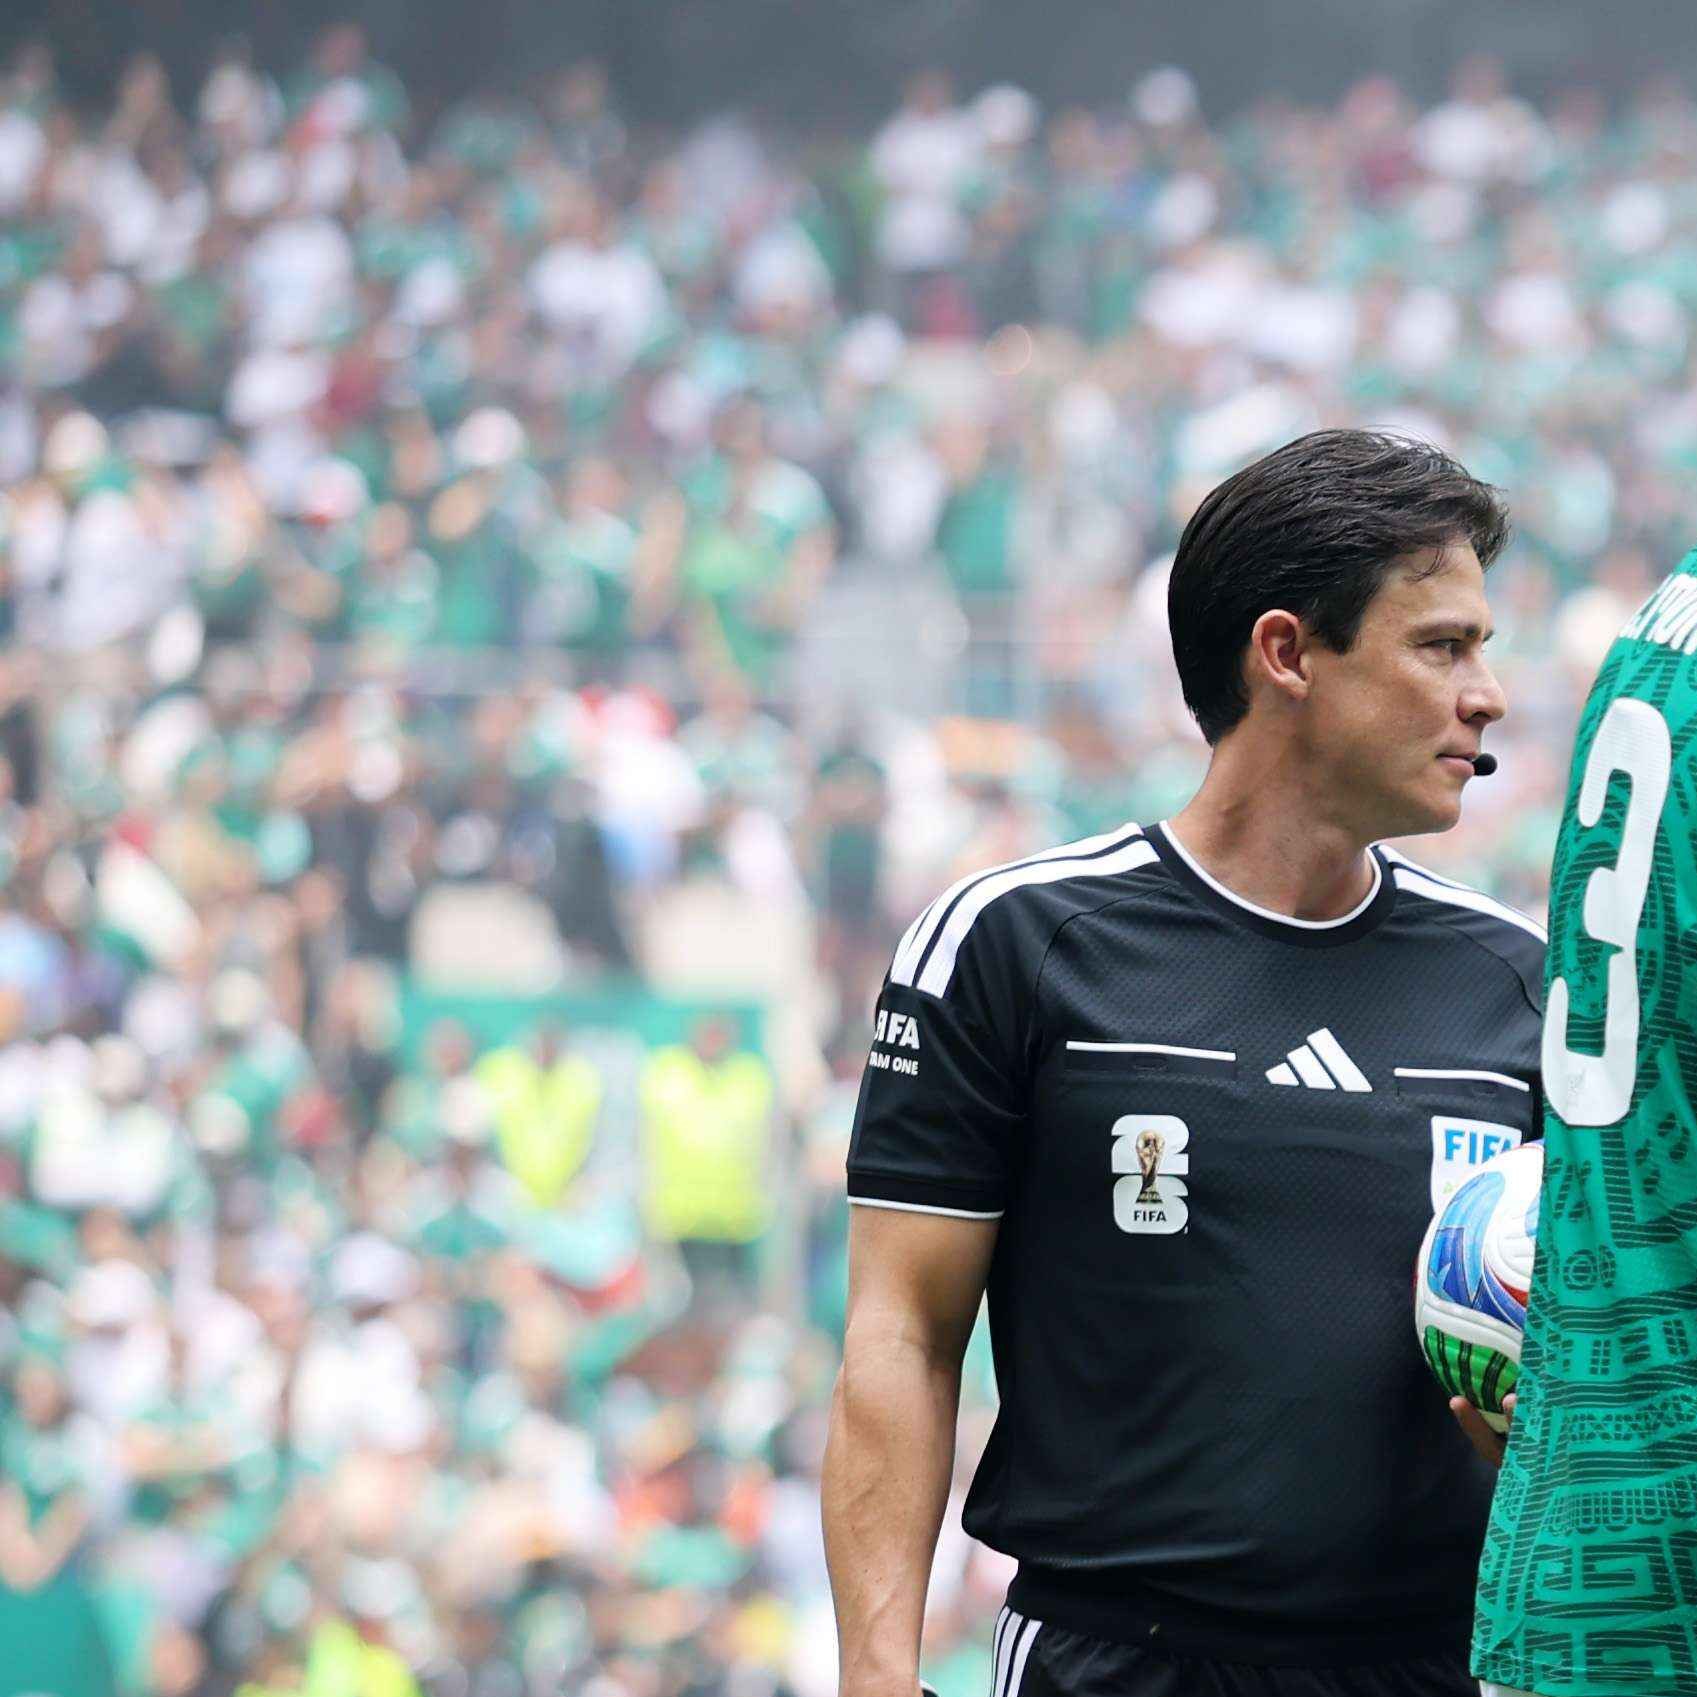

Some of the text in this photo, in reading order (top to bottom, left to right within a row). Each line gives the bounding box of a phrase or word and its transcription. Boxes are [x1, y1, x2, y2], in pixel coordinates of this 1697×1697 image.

[1541, 697, 1671, 1126] 3
[874, 1009, 920, 1050] IFA
[869, 1051, 919, 1076] AM ONE
[1134, 1210, 1167, 1222] FIFA
